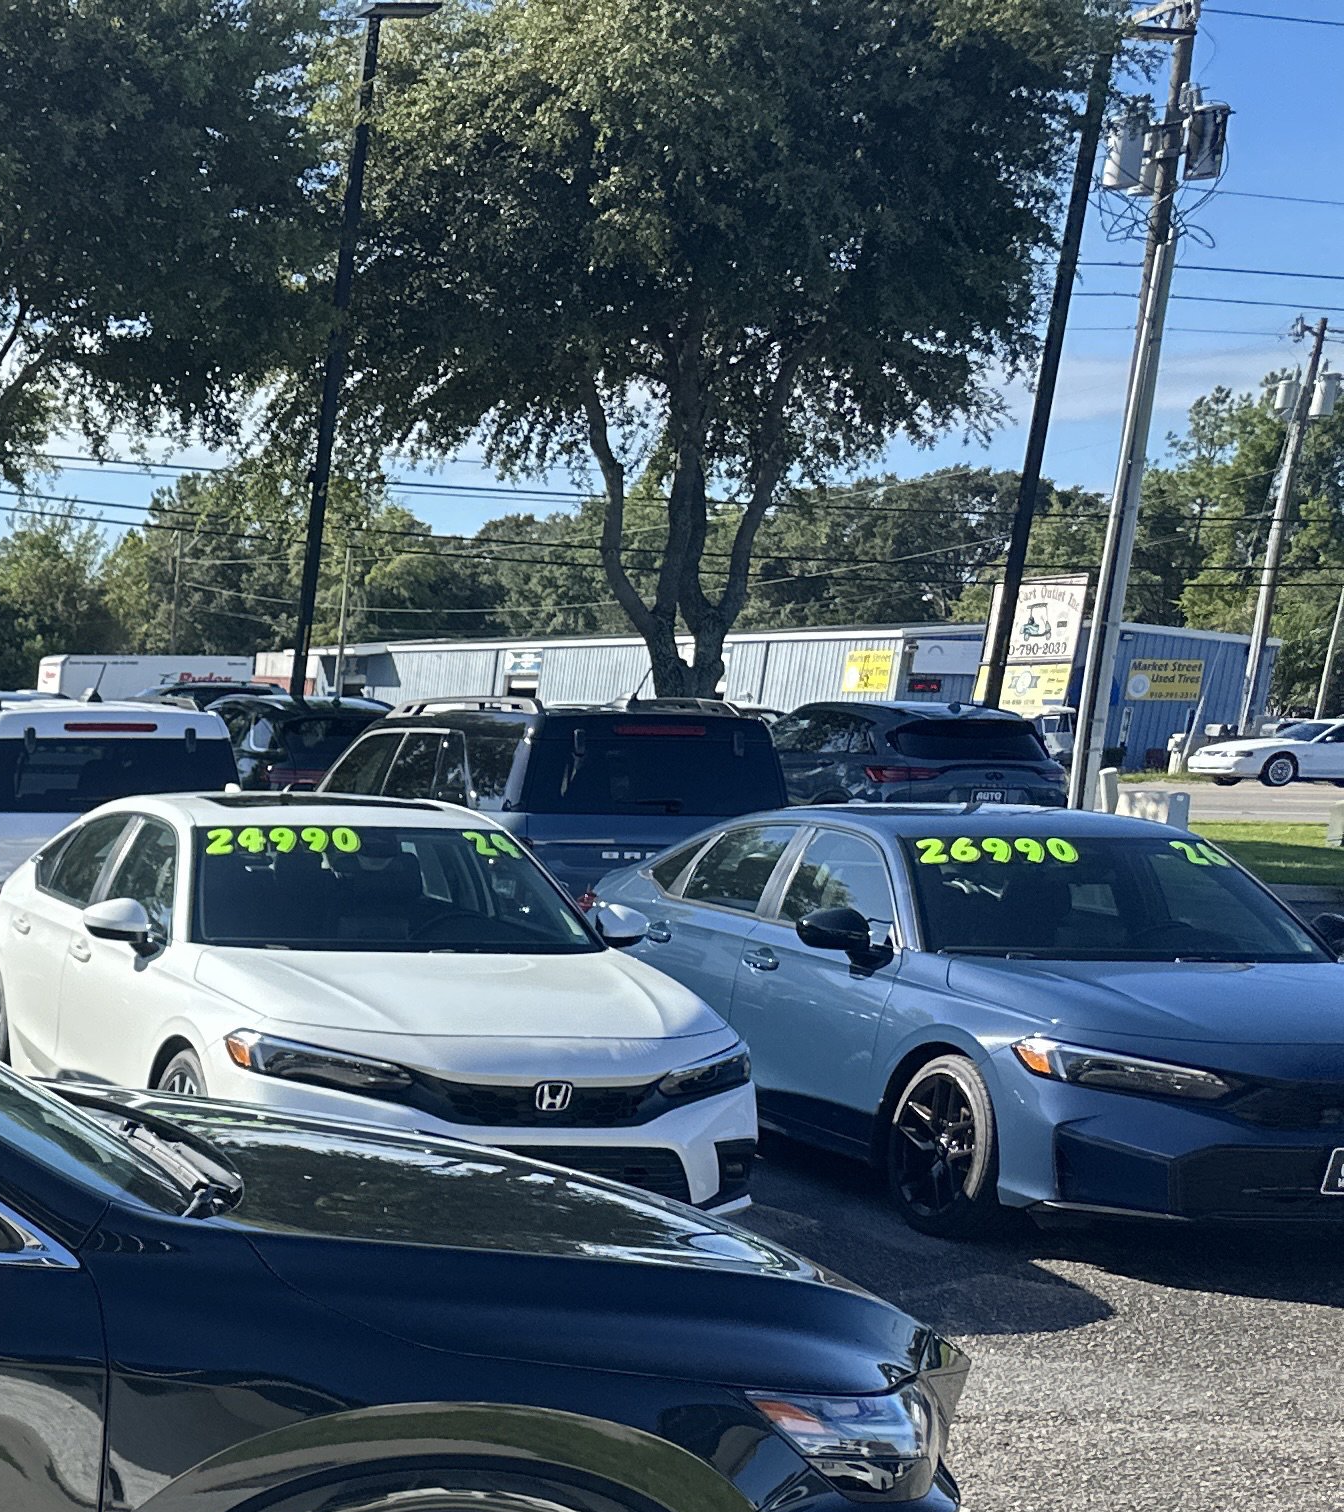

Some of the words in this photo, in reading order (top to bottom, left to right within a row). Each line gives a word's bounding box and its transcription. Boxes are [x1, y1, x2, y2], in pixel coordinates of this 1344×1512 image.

[1041, 585, 1066, 602] Outlet
[1131, 661, 1170, 671] Market
[1171, 661, 1203, 672] Street
[1151, 674, 1175, 683] Used
[1178, 674, 1201, 684] Tires
[976, 792, 1003, 801] AUTO
[205, 827, 362, 856] 24990
[462, 831, 524, 859] 24
[916, 837, 1080, 864] 26990
[1168, 840, 1232, 868] 26
